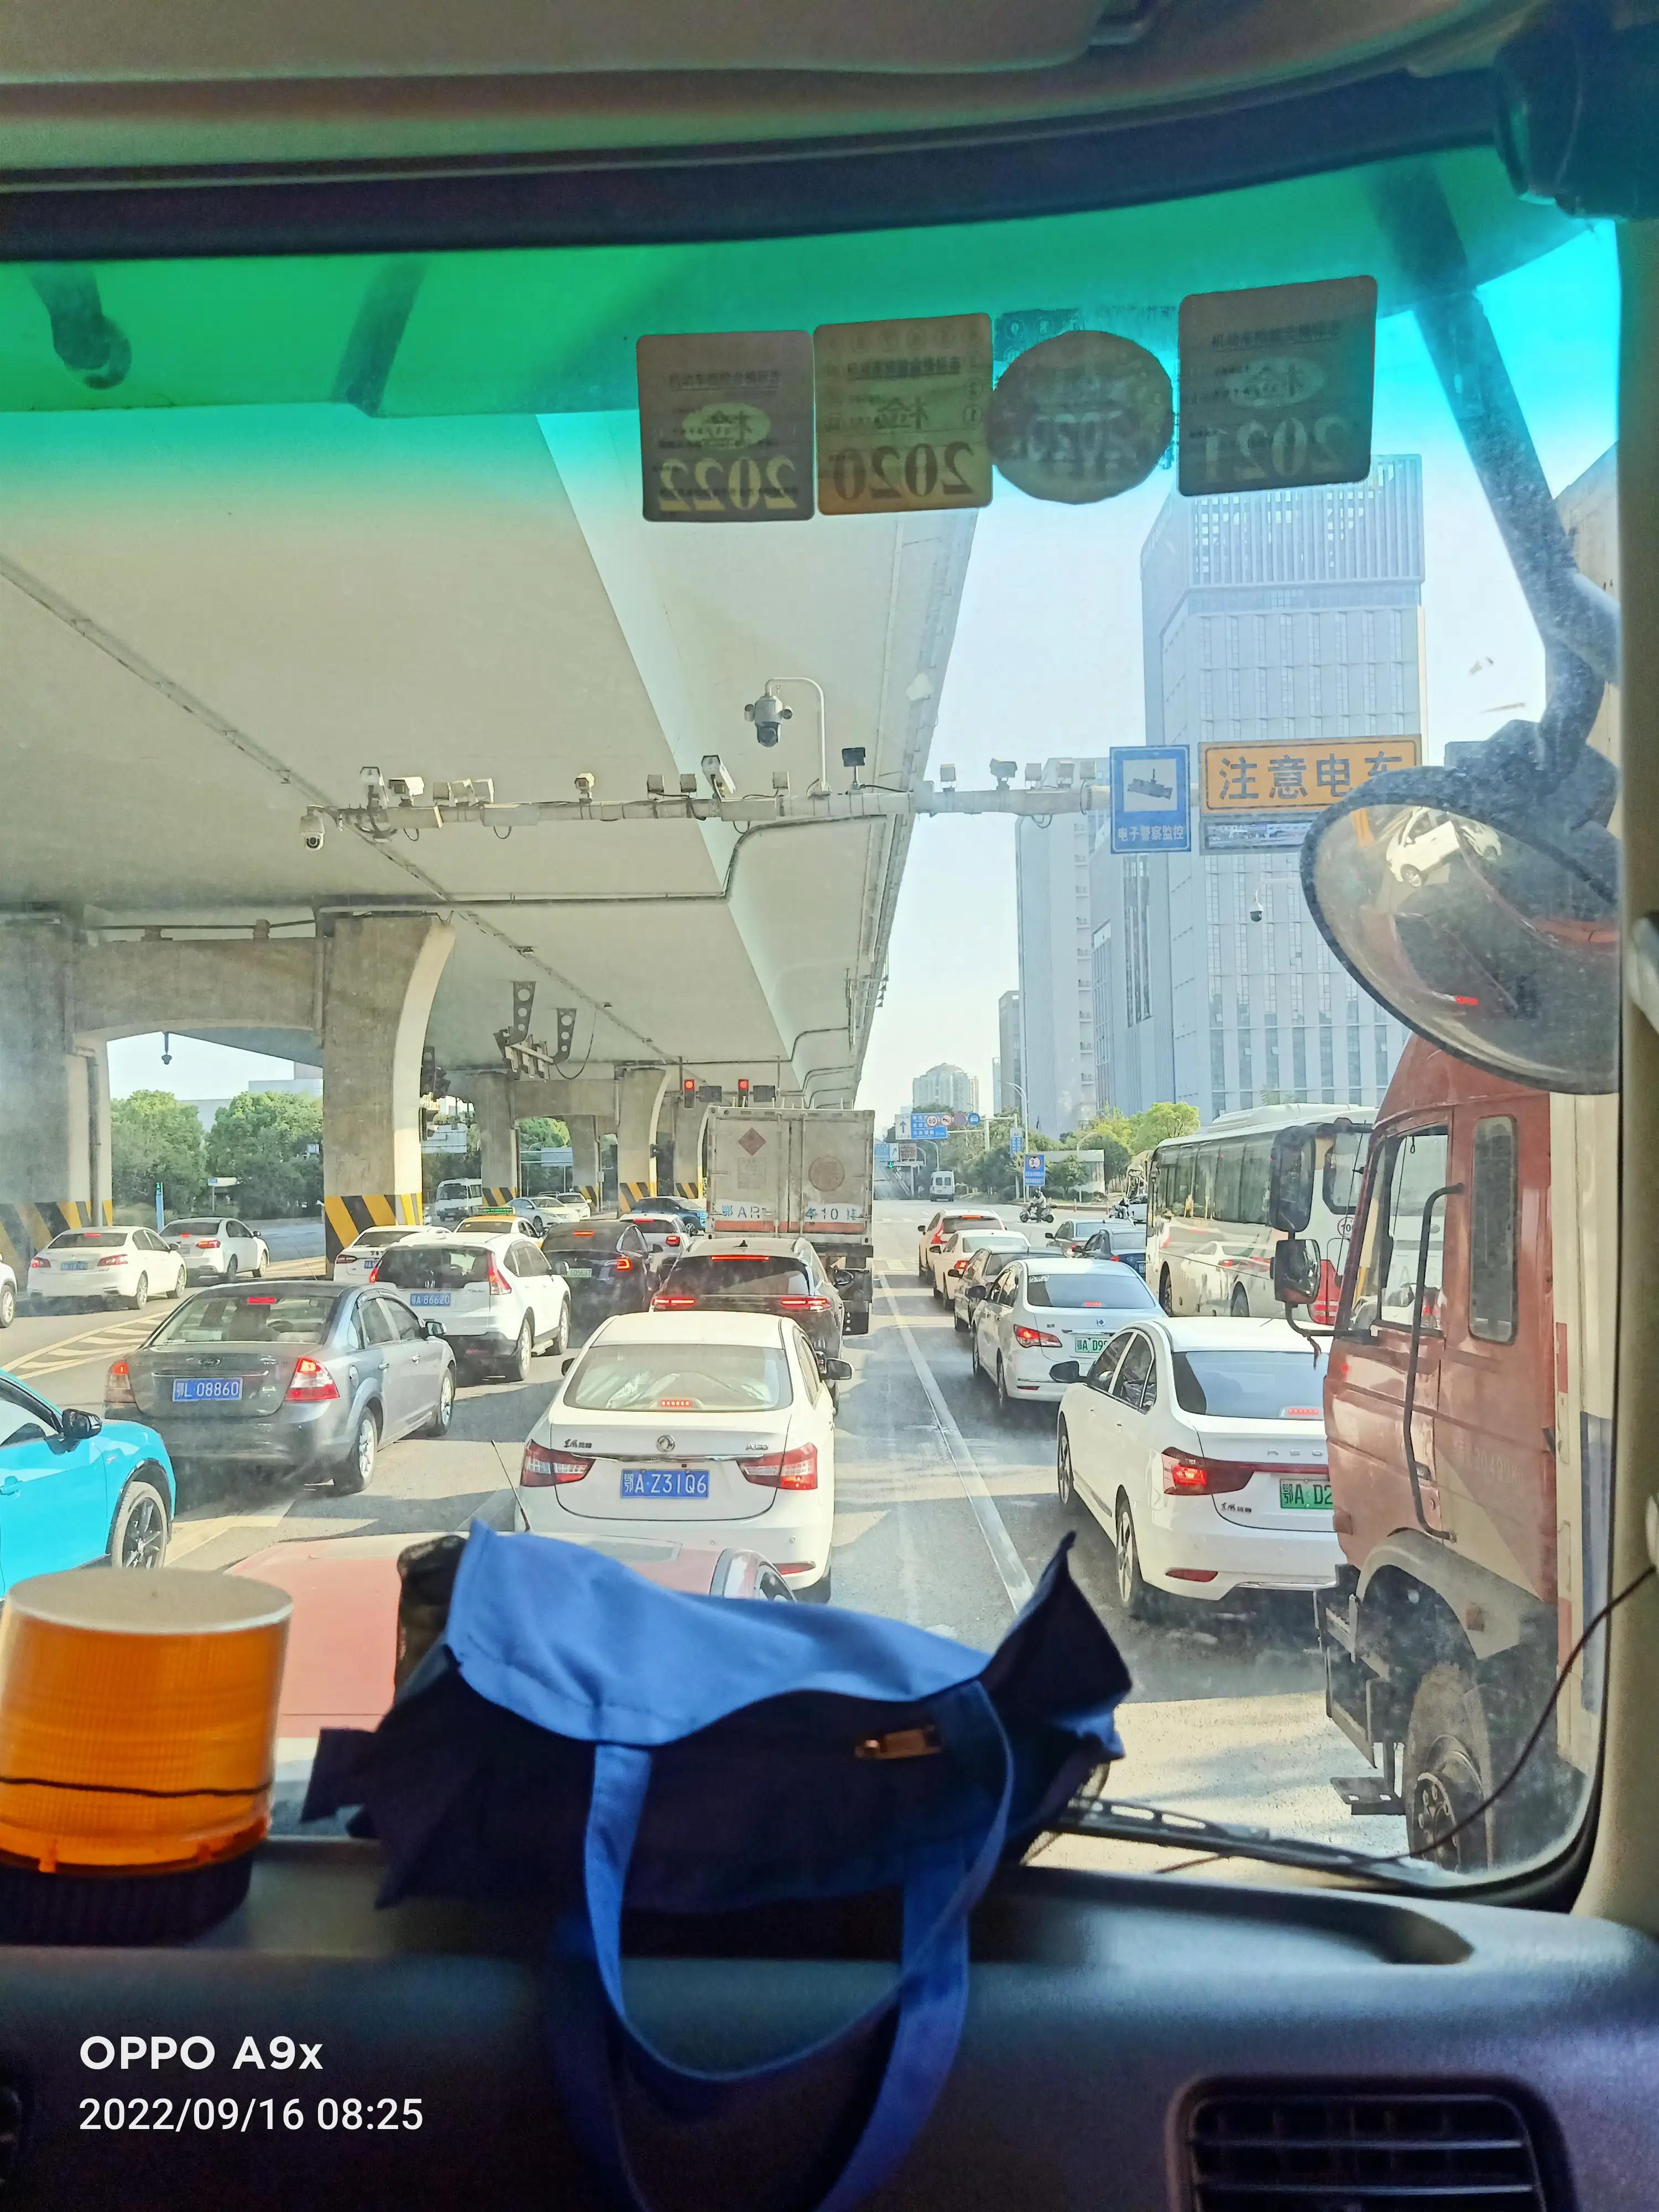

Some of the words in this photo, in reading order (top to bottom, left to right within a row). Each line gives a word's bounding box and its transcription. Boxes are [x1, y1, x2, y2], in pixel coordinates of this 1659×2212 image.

[1118, 825, 1184, 842] 电子警察监控
